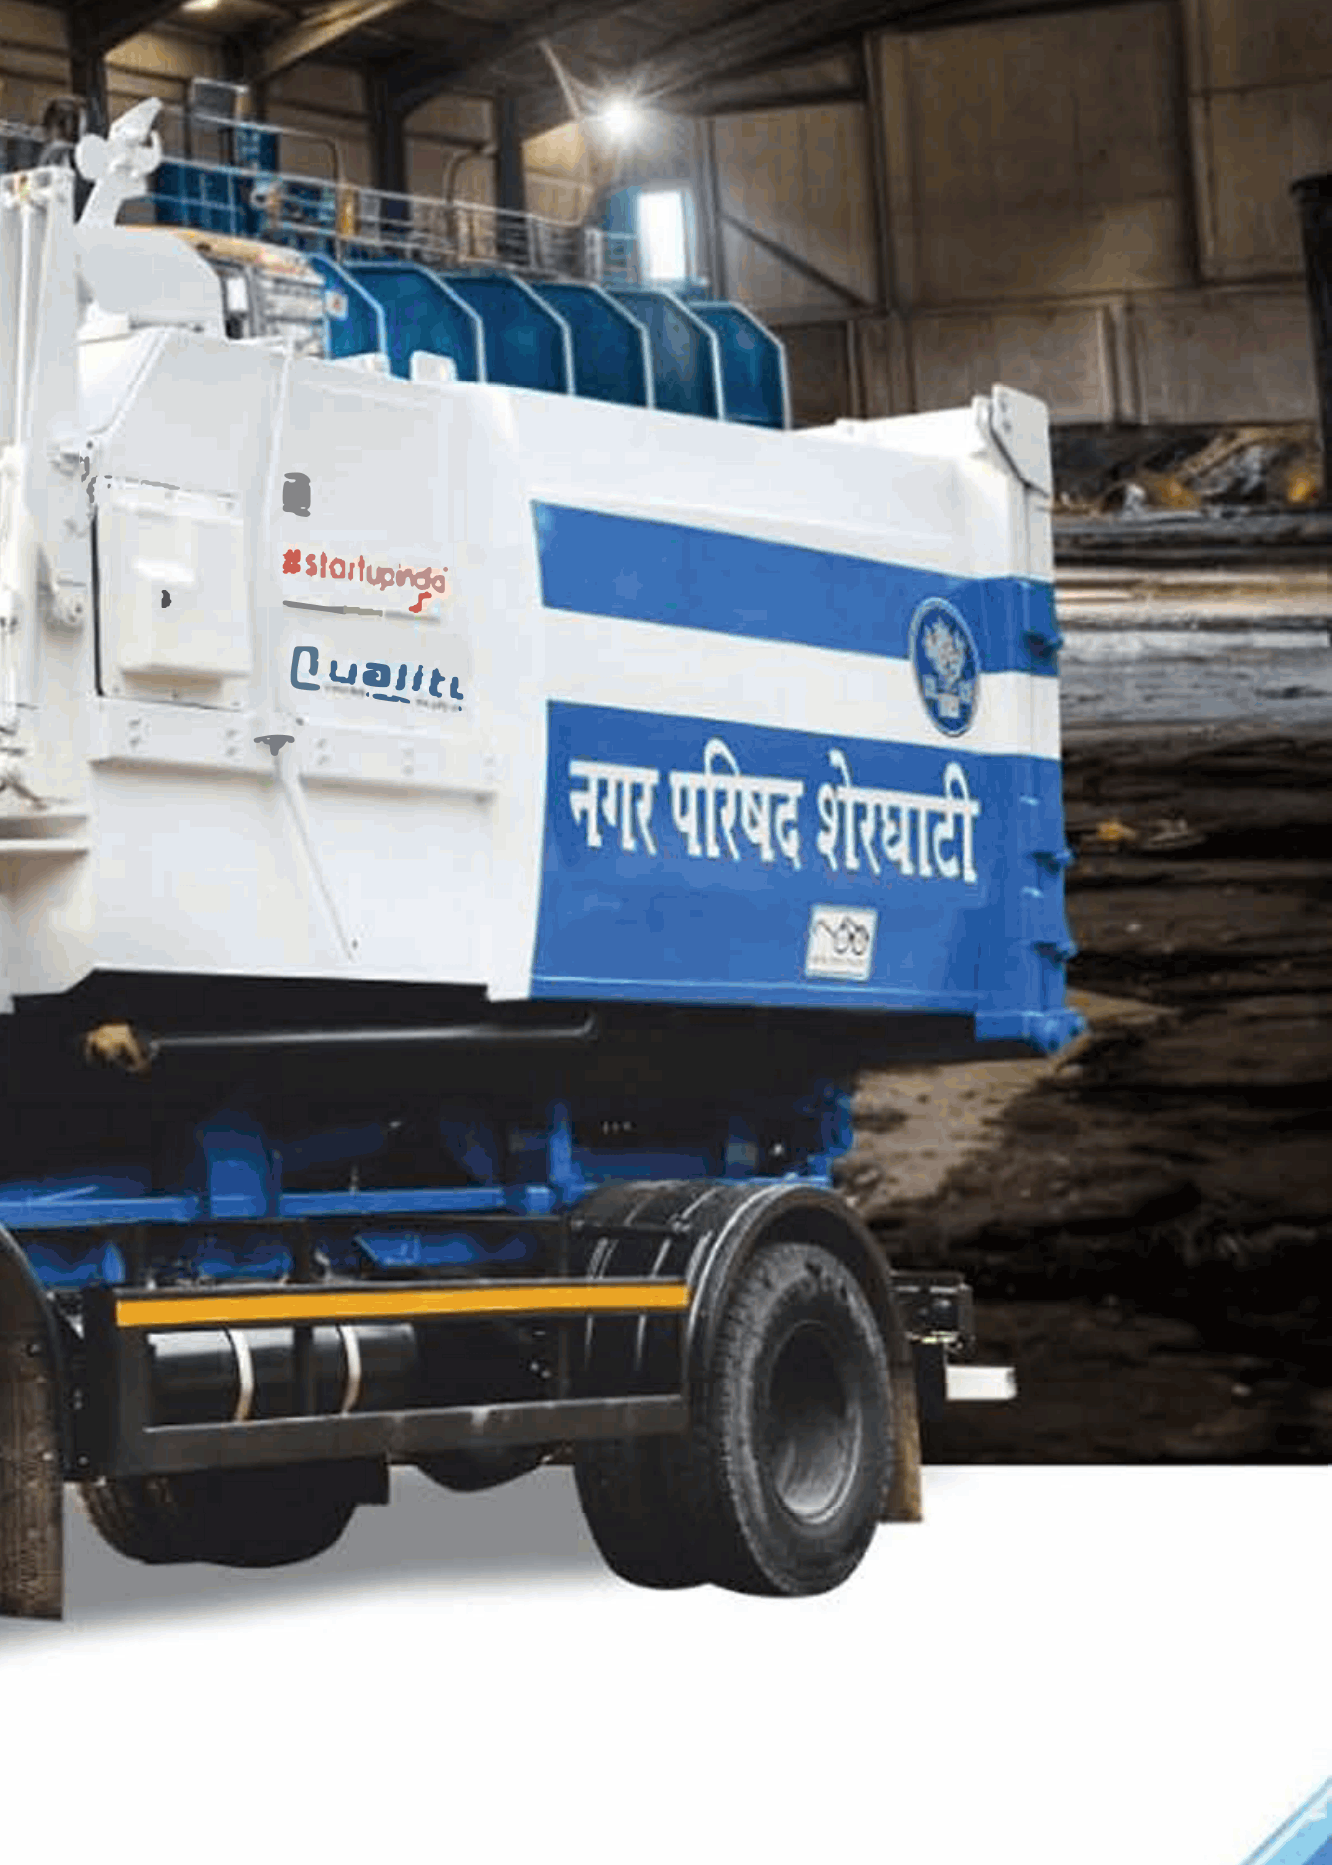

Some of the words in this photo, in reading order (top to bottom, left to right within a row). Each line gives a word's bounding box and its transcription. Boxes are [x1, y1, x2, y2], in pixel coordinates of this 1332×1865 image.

[569, 760, 659, 857] नगर
[669, 737, 804, 872] परिषद
[817, 748, 981, 884] शेरघाटी
